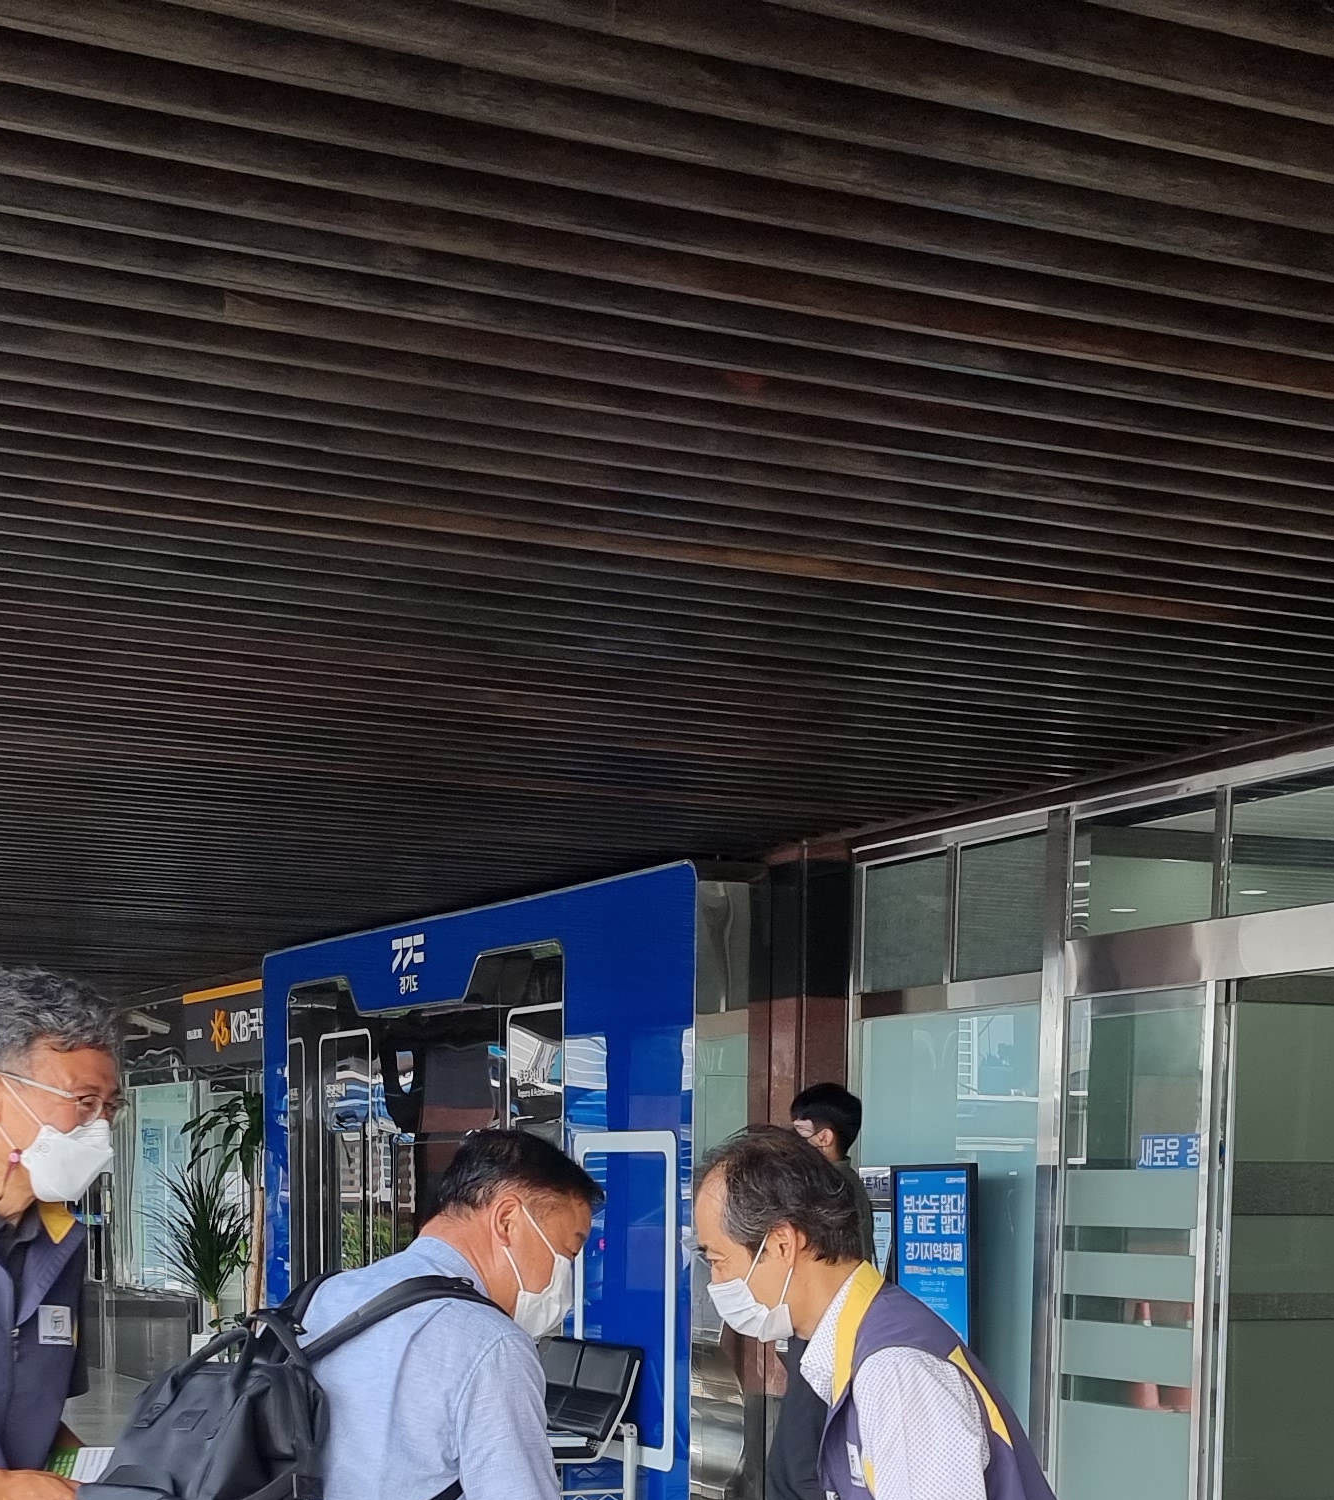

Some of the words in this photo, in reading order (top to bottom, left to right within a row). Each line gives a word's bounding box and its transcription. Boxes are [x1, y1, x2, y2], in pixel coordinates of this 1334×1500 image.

[399, 975, 419, 995] 경기도
[230, 1006, 263, 1044] KB국
[1138, 1138, 1180, 1167] 새로운
[903, 1194, 940, 1214] 보너스도
[940, 1194, 966, 1214] 많다!
[903, 1214, 914, 1234] 쓸
[917, 1214, 936, 1235] 데도
[940, 1214, 966, 1235] 많다!
[905, 1242, 963, 1261] 경기지역화폐
